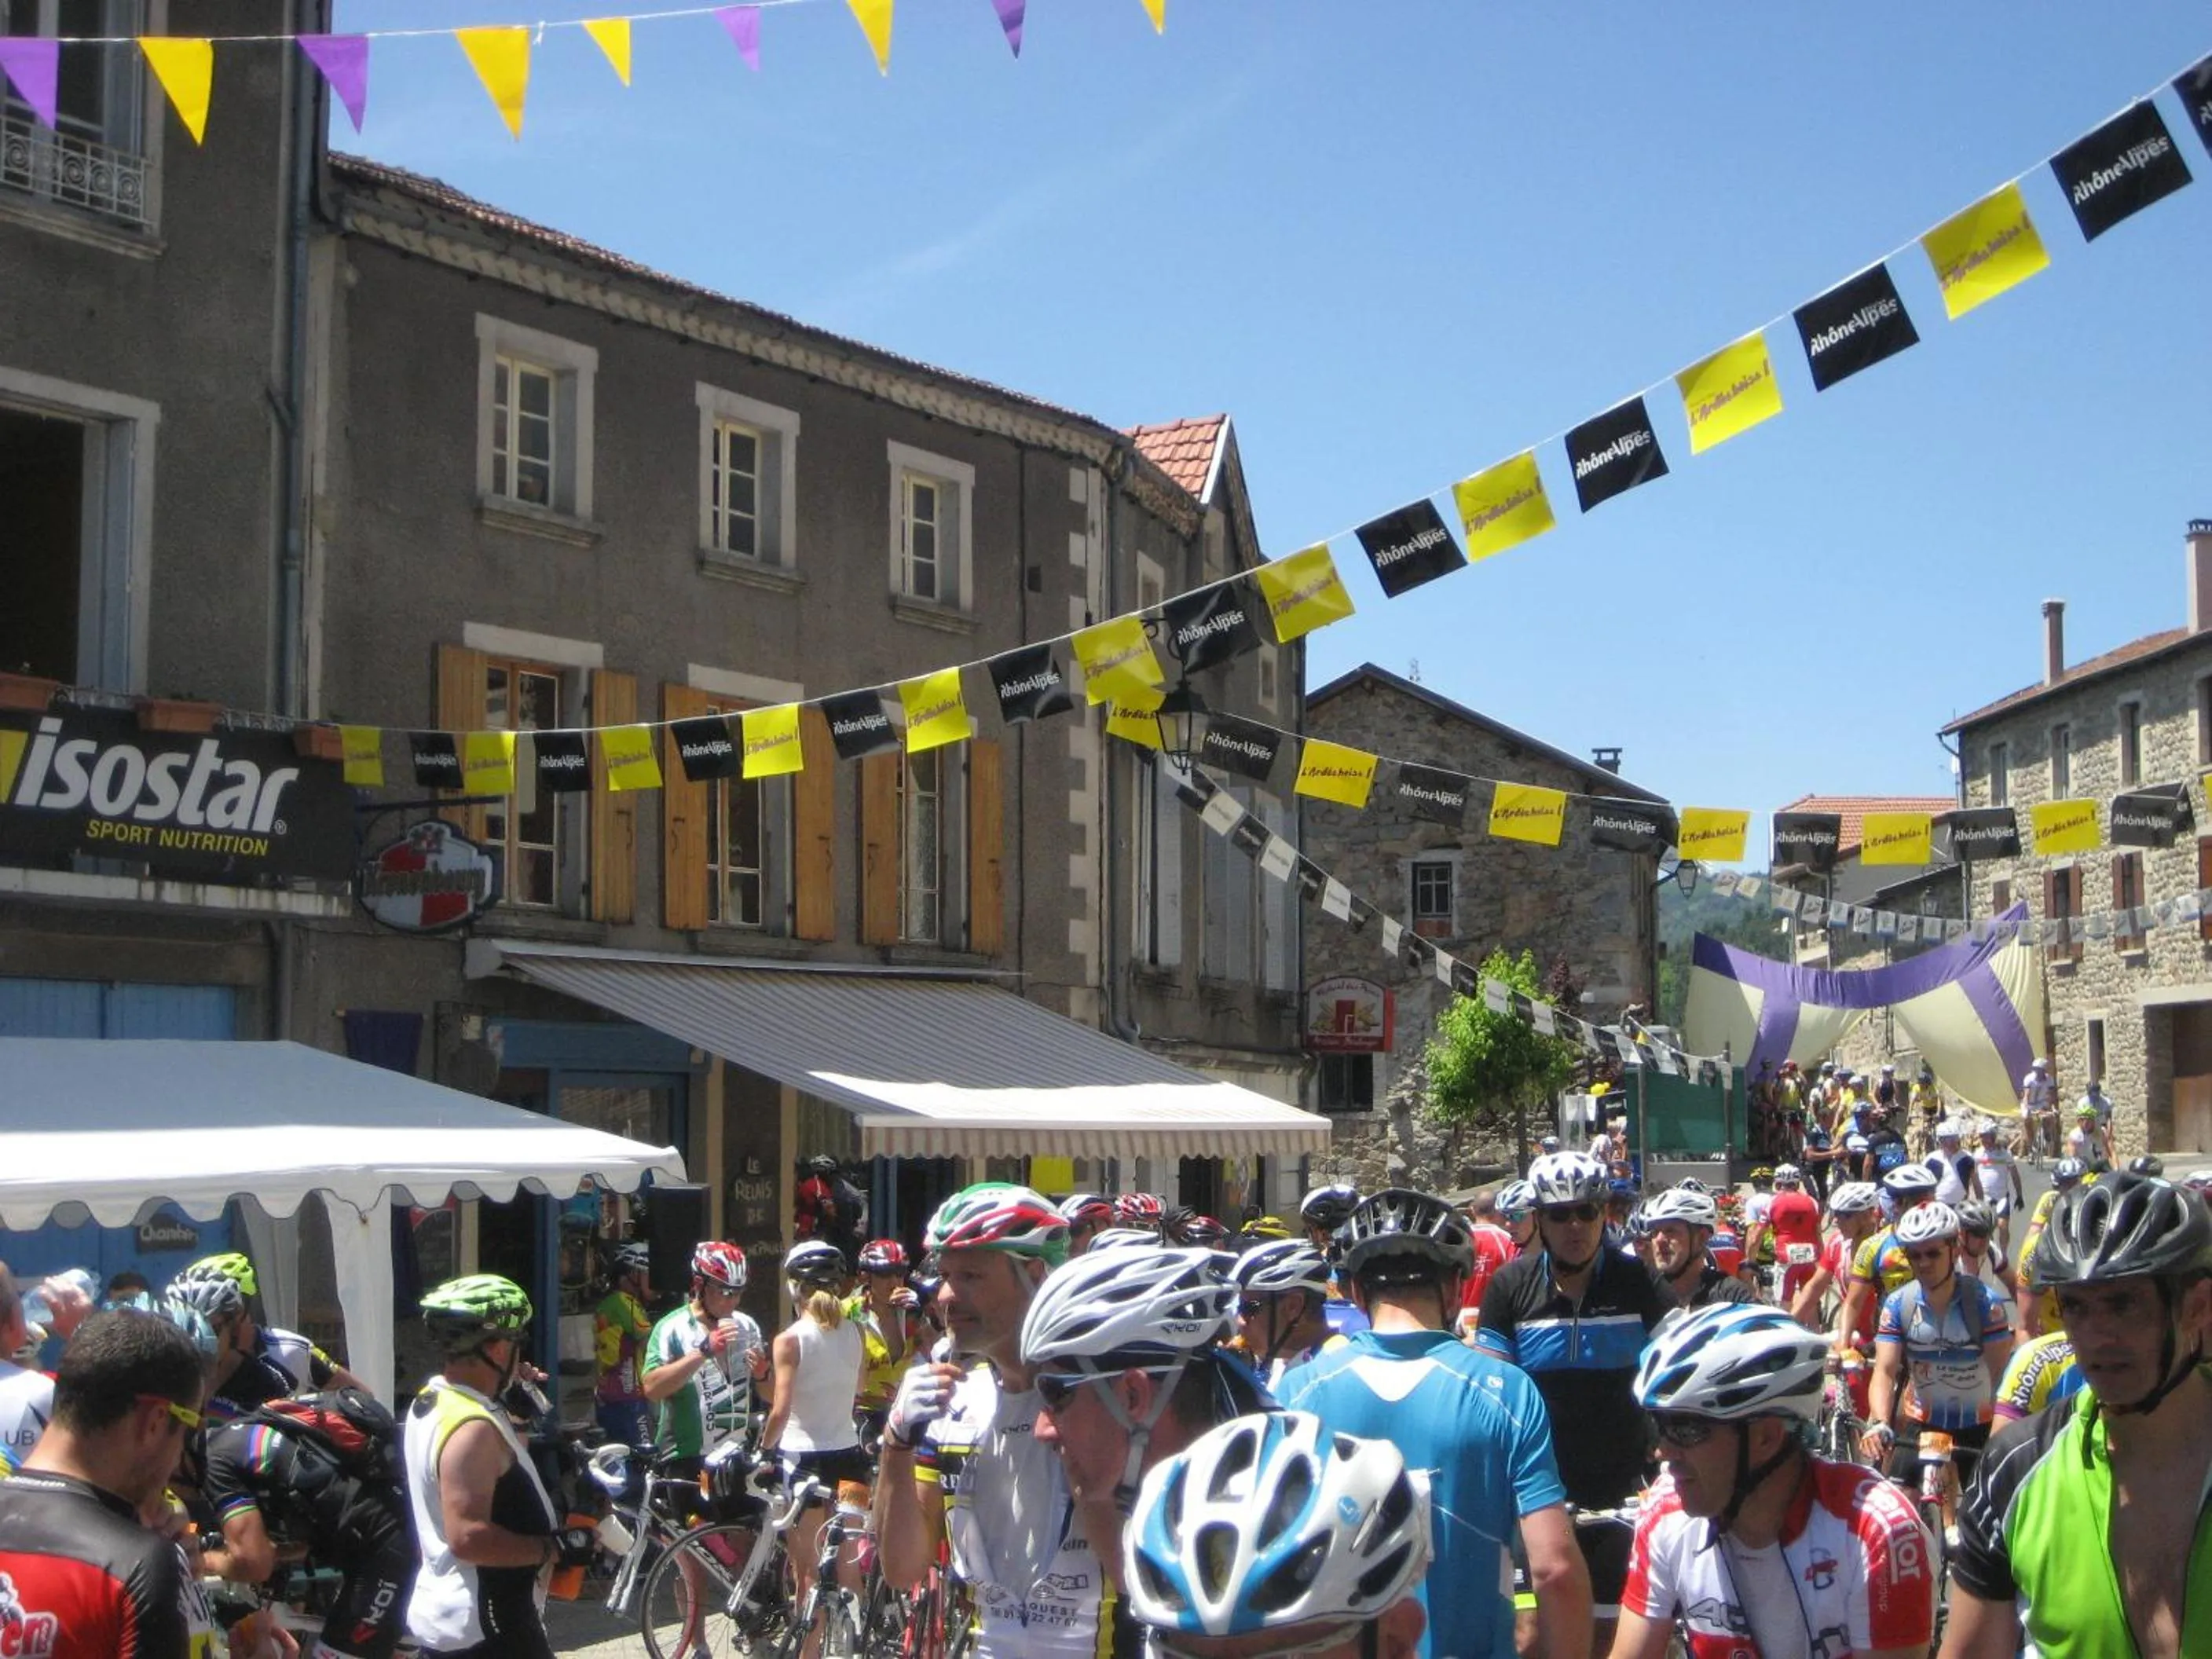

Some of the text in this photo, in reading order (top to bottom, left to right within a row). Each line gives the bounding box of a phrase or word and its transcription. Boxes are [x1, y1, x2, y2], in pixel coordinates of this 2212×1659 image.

[15, 717, 298, 833] isostar
[86, 819, 269, 856] SPORT NUTRITION
